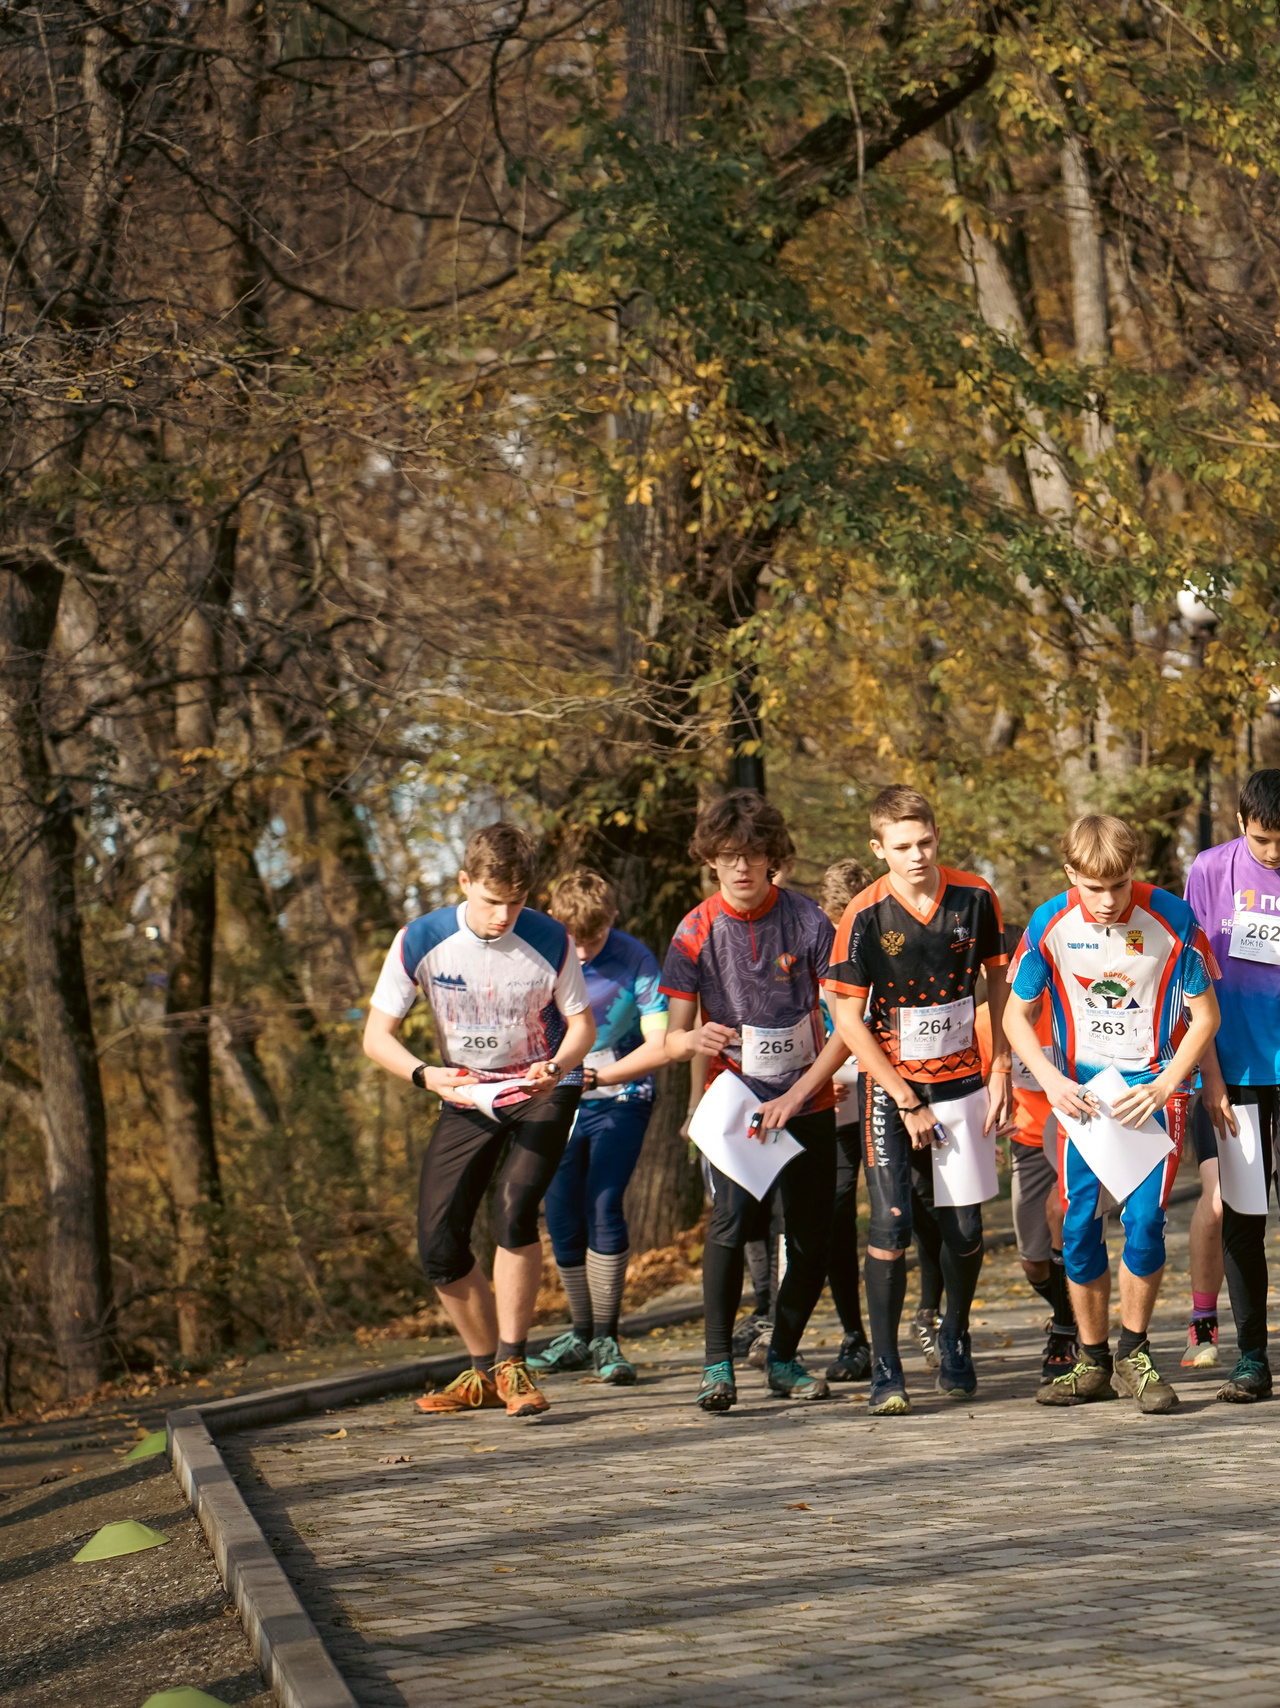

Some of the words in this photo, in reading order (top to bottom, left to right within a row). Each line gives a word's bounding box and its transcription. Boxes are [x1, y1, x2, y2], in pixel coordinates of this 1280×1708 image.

[1246, 922, 1280, 942] 262
[1240, 938, 1264, 948] МЖ16
[1103, 970, 1136, 988] ВОРОНЕЖ
[919, 1017, 951, 1036] 264
[1091, 1020, 1125, 1036] 263
[1132, 1028, 1138, 1037] 1
[462, 1036, 498, 1049] 266
[760, 1039, 794, 1054] 265
